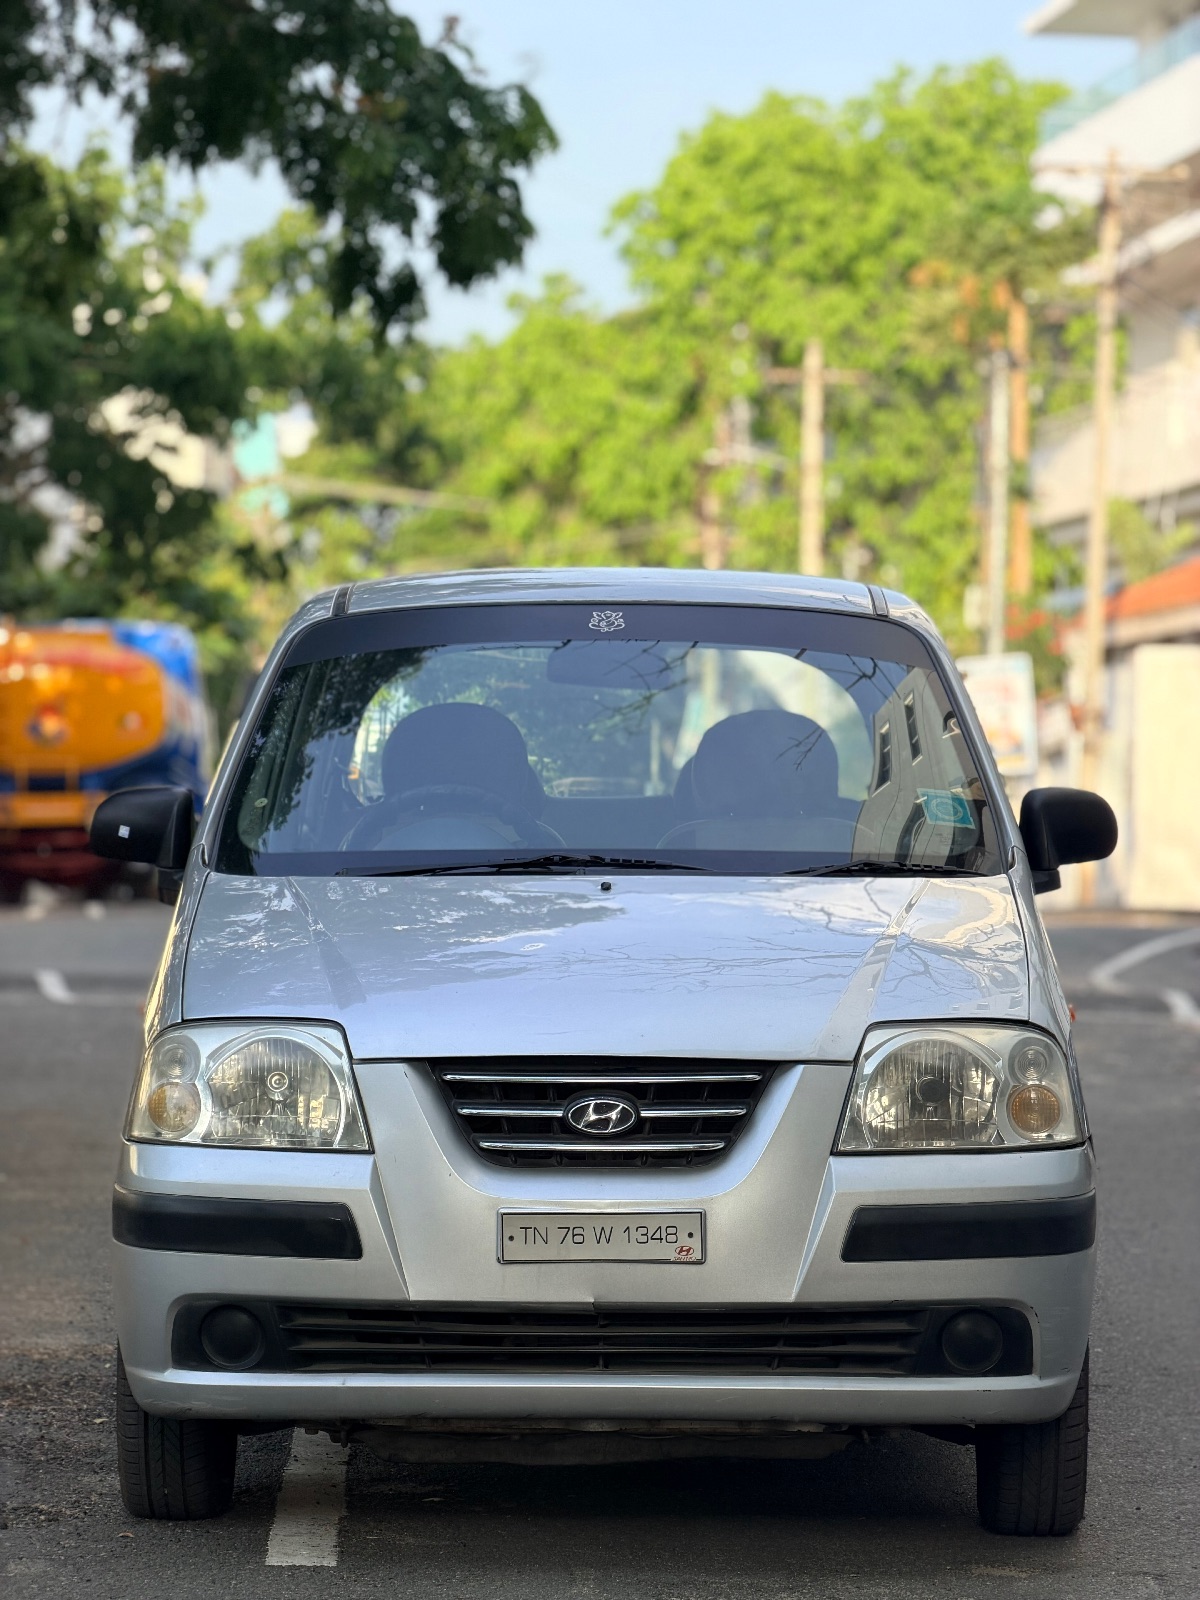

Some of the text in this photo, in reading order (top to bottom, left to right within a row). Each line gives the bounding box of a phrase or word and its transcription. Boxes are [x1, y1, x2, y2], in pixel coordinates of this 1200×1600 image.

[519, 1225, 679, 1245] TN 76 W 1348
